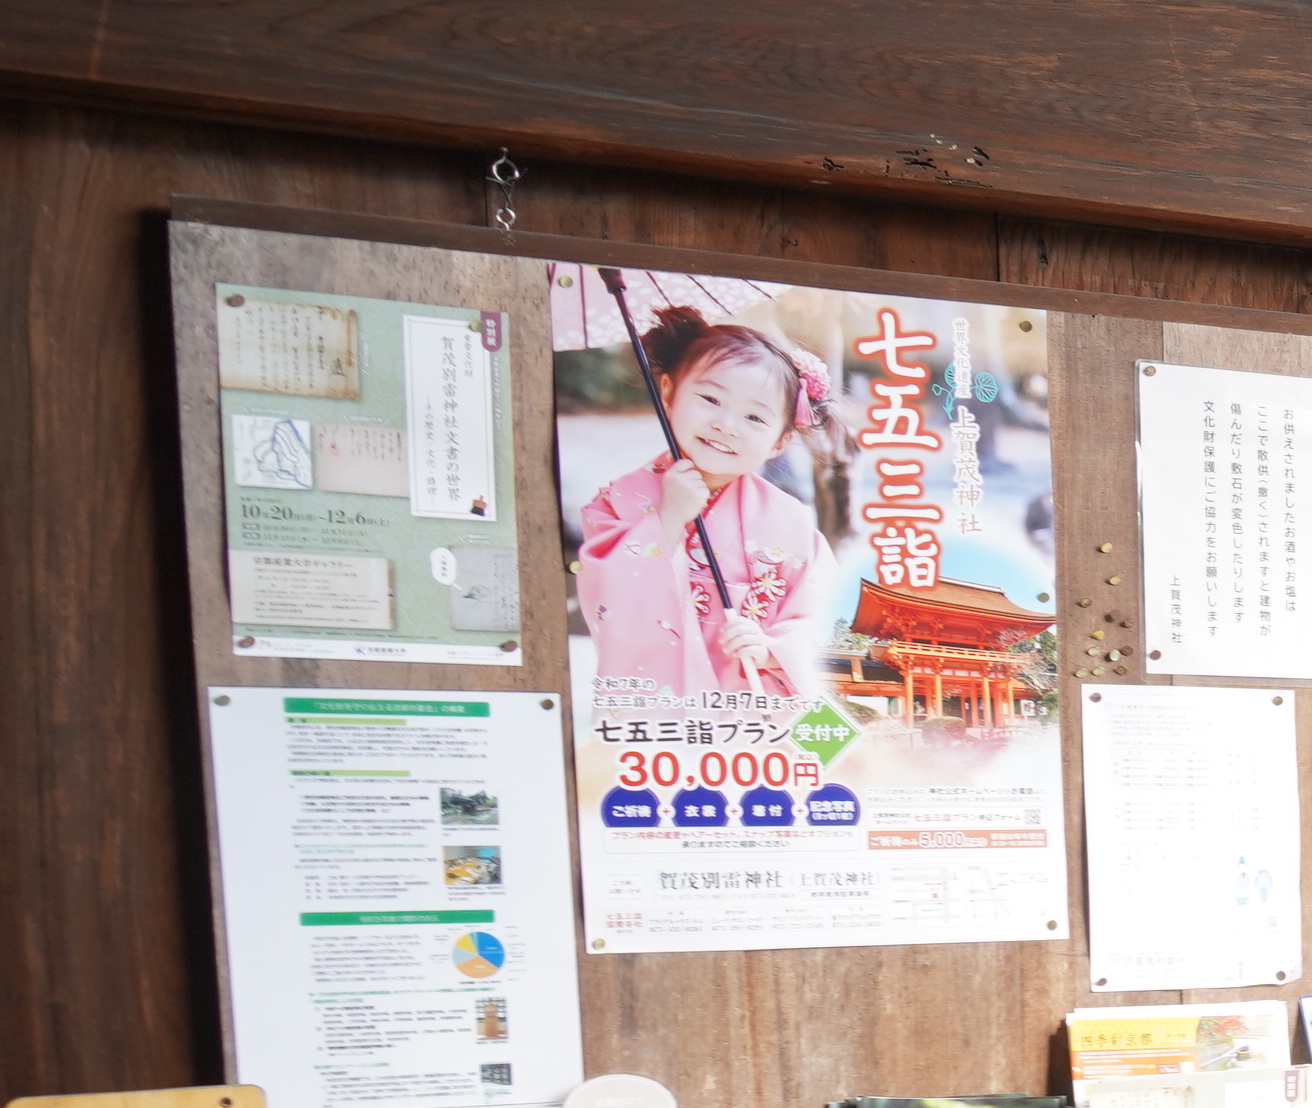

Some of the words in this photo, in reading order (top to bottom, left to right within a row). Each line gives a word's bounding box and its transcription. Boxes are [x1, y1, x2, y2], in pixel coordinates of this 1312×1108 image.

[952, 319, 972, 399] 世界文化遺産
[441, 335, 462, 502] 賀茂別雷神社文書の世界
[857, 311, 941, 588] 七五三詣
[950, 407, 983, 536] 上賀茂神社
[1283, 409, 1297, 612] お供えされましたお酒やお塩は
[1202, 400, 1219, 637] 文化財保護にご協力をお願いします
[1230, 403, 1245, 623] 傷んだり敷石が変色したりします
[1170, 575, 1183, 643] 上賀茂神社
[592, 677, 656, 690] 令和7年の
[594, 719, 790, 745] 七五三詣プラン
[619, 751, 820, 789] 30,000円
[795, 724, 851, 742] 受付中
[660, 870, 783, 890] 賀茂別雷神社
